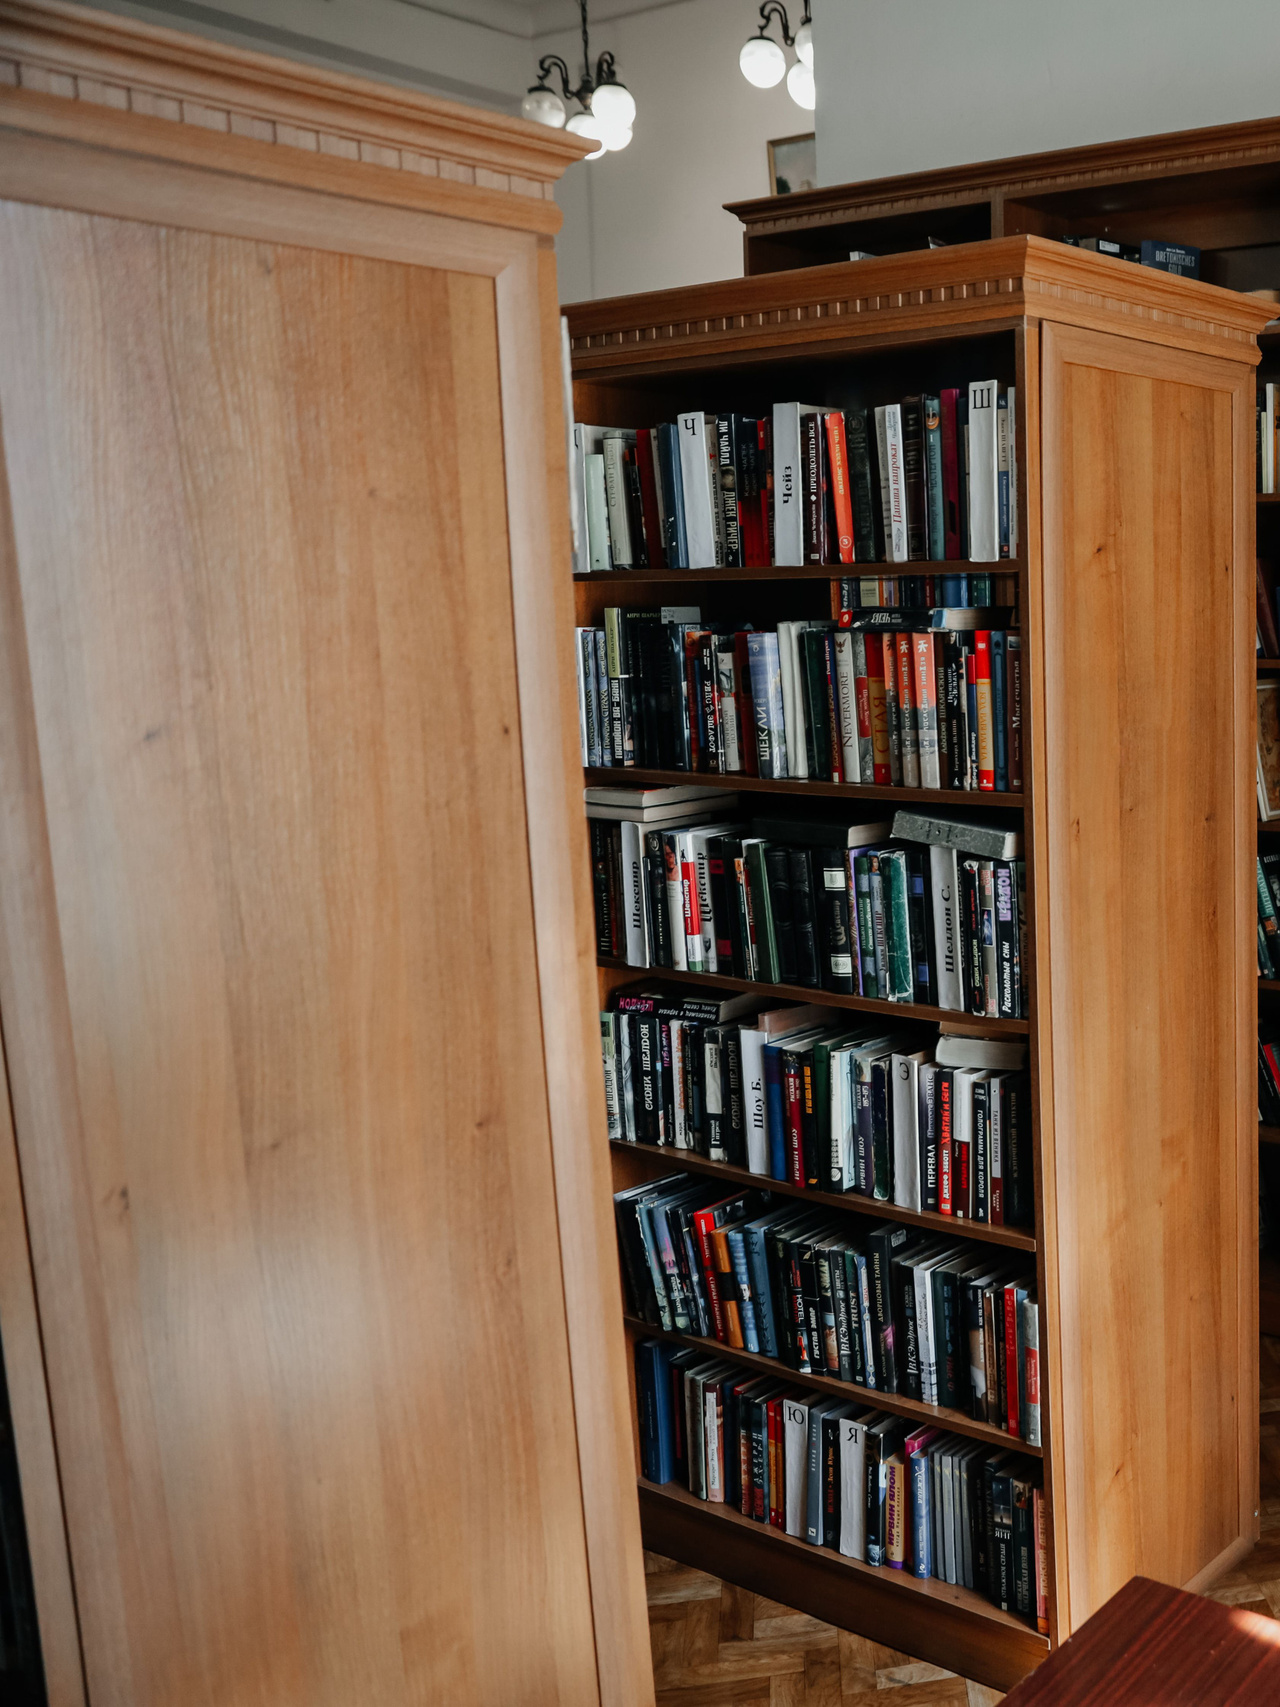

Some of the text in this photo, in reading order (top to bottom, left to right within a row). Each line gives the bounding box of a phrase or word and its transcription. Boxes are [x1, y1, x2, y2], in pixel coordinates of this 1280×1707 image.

[971, 387, 991, 409] Ш
[683, 418, 697, 436] Ч
[718, 421, 731, 466] ЛИ ЧАЙЛД
[781, 465, 793, 505] Чейз
[889, 442, 902, 524] Папаша напрокат
[839, 671, 854, 749] NEVERMORE
[1011, 660, 1022, 729] Мыс счастья
[755, 706, 771, 760] ШЕКЛИ
[872, 695, 890, 753] СТАЯ
[631, 861, 642, 929] Шекспир
[941, 885, 955, 973] Шелдон С.
[1001, 941, 1012, 1013] Расколотые сны
[639, 1023, 654, 1111] СИДНИ ШЕЛДОН
[727, 1040, 741, 1130] СИДНИ ШЕЛДОН
[899, 1061, 910, 1081] Э
[926, 1073, 934, 1105] ЭВАНС
[751, 1077, 766, 1130] Шоу Б.
[857, 1134, 867, 1189] ИРВИН ШОУ
[927, 1143, 937, 1188] ПЕРЕВАЛ
[976, 1109, 985, 1198] ГОЛОГРАММА ДЛЯ КОРОЛЯ
[849, 1290, 859, 1330] TRUST
[872, 1251, 884, 1323] ДВОРЦОВЫЕ ТАЙНЫ
[808, 1306, 820, 1360] ГУСТАВ ЭМАР
[785, 1406, 805, 1425] Ю
[844, 1426, 860, 1445] Я
[887, 1465, 896, 1547] ИРВИН ЯЛОМ
